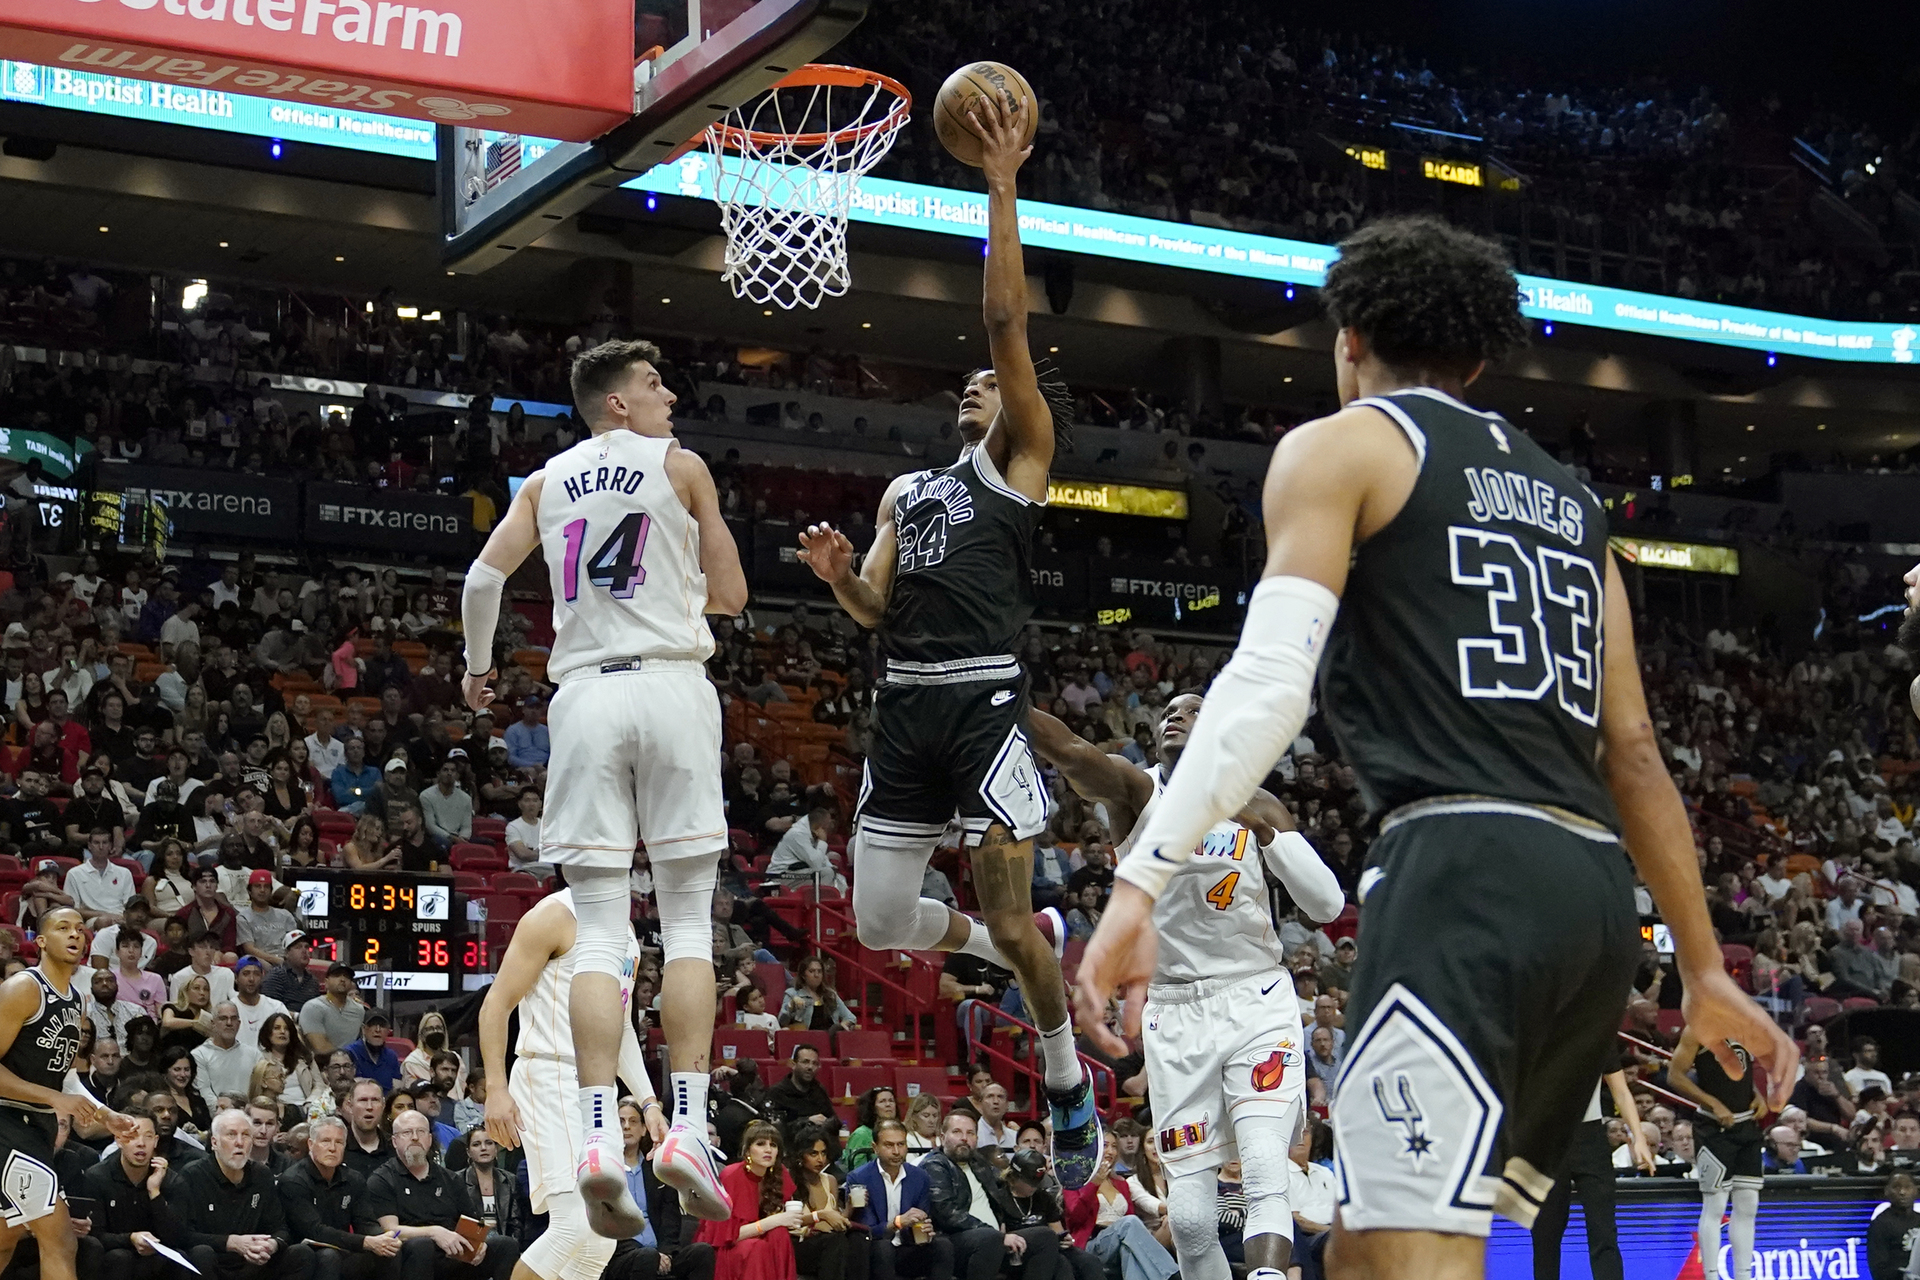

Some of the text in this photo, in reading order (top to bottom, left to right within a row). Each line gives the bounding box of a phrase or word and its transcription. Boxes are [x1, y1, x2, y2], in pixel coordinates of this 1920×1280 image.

[53, 67, 234, 118] Baptist Health
[271, 105, 432, 143] Official Healthcare
[850, 186, 989, 227] Baptist Health
[1018, 214, 1326, 273] Official Healthcare Provider of the Miami HEAT
[1537, 287, 1593, 316] Health
[1615, 302, 1658, 323] Official
[1658, 310, 1720, 332] Healthcare
[1720, 318, 1768, 340] Provider
[1768, 326, 1783, 340] of
[1783, 327, 1802, 343] the
[1837, 334, 1874, 350] HEAT
[563, 466, 645, 503] HERRO
[906, 476, 974, 526] ANTONIO
[1049, 486, 1110, 508] BACARDÍ
[1464, 467, 1584, 546] JONES
[563, 512, 651, 607] 14
[898, 513, 947, 576] 24
[1640, 546, 1692, 566] BACARDÍ
[1030, 568, 1064, 588] ena
[1447, 525, 1604, 729] 33
[350, 884, 414, 911] 8:34
[1206, 872, 1242, 911] 4
[412, 922, 441, 933] SPURS
[365, 938, 380, 965] 2
[418, 939, 449, 967] 36
[374, 977, 412, 986] EAT
[36, 1014, 64, 1049] SAN
[47, 1036, 81, 1073] 35
[1161, 1119, 1210, 1154] HEAT
[1716, 1237, 1861, 1280] Carnival
